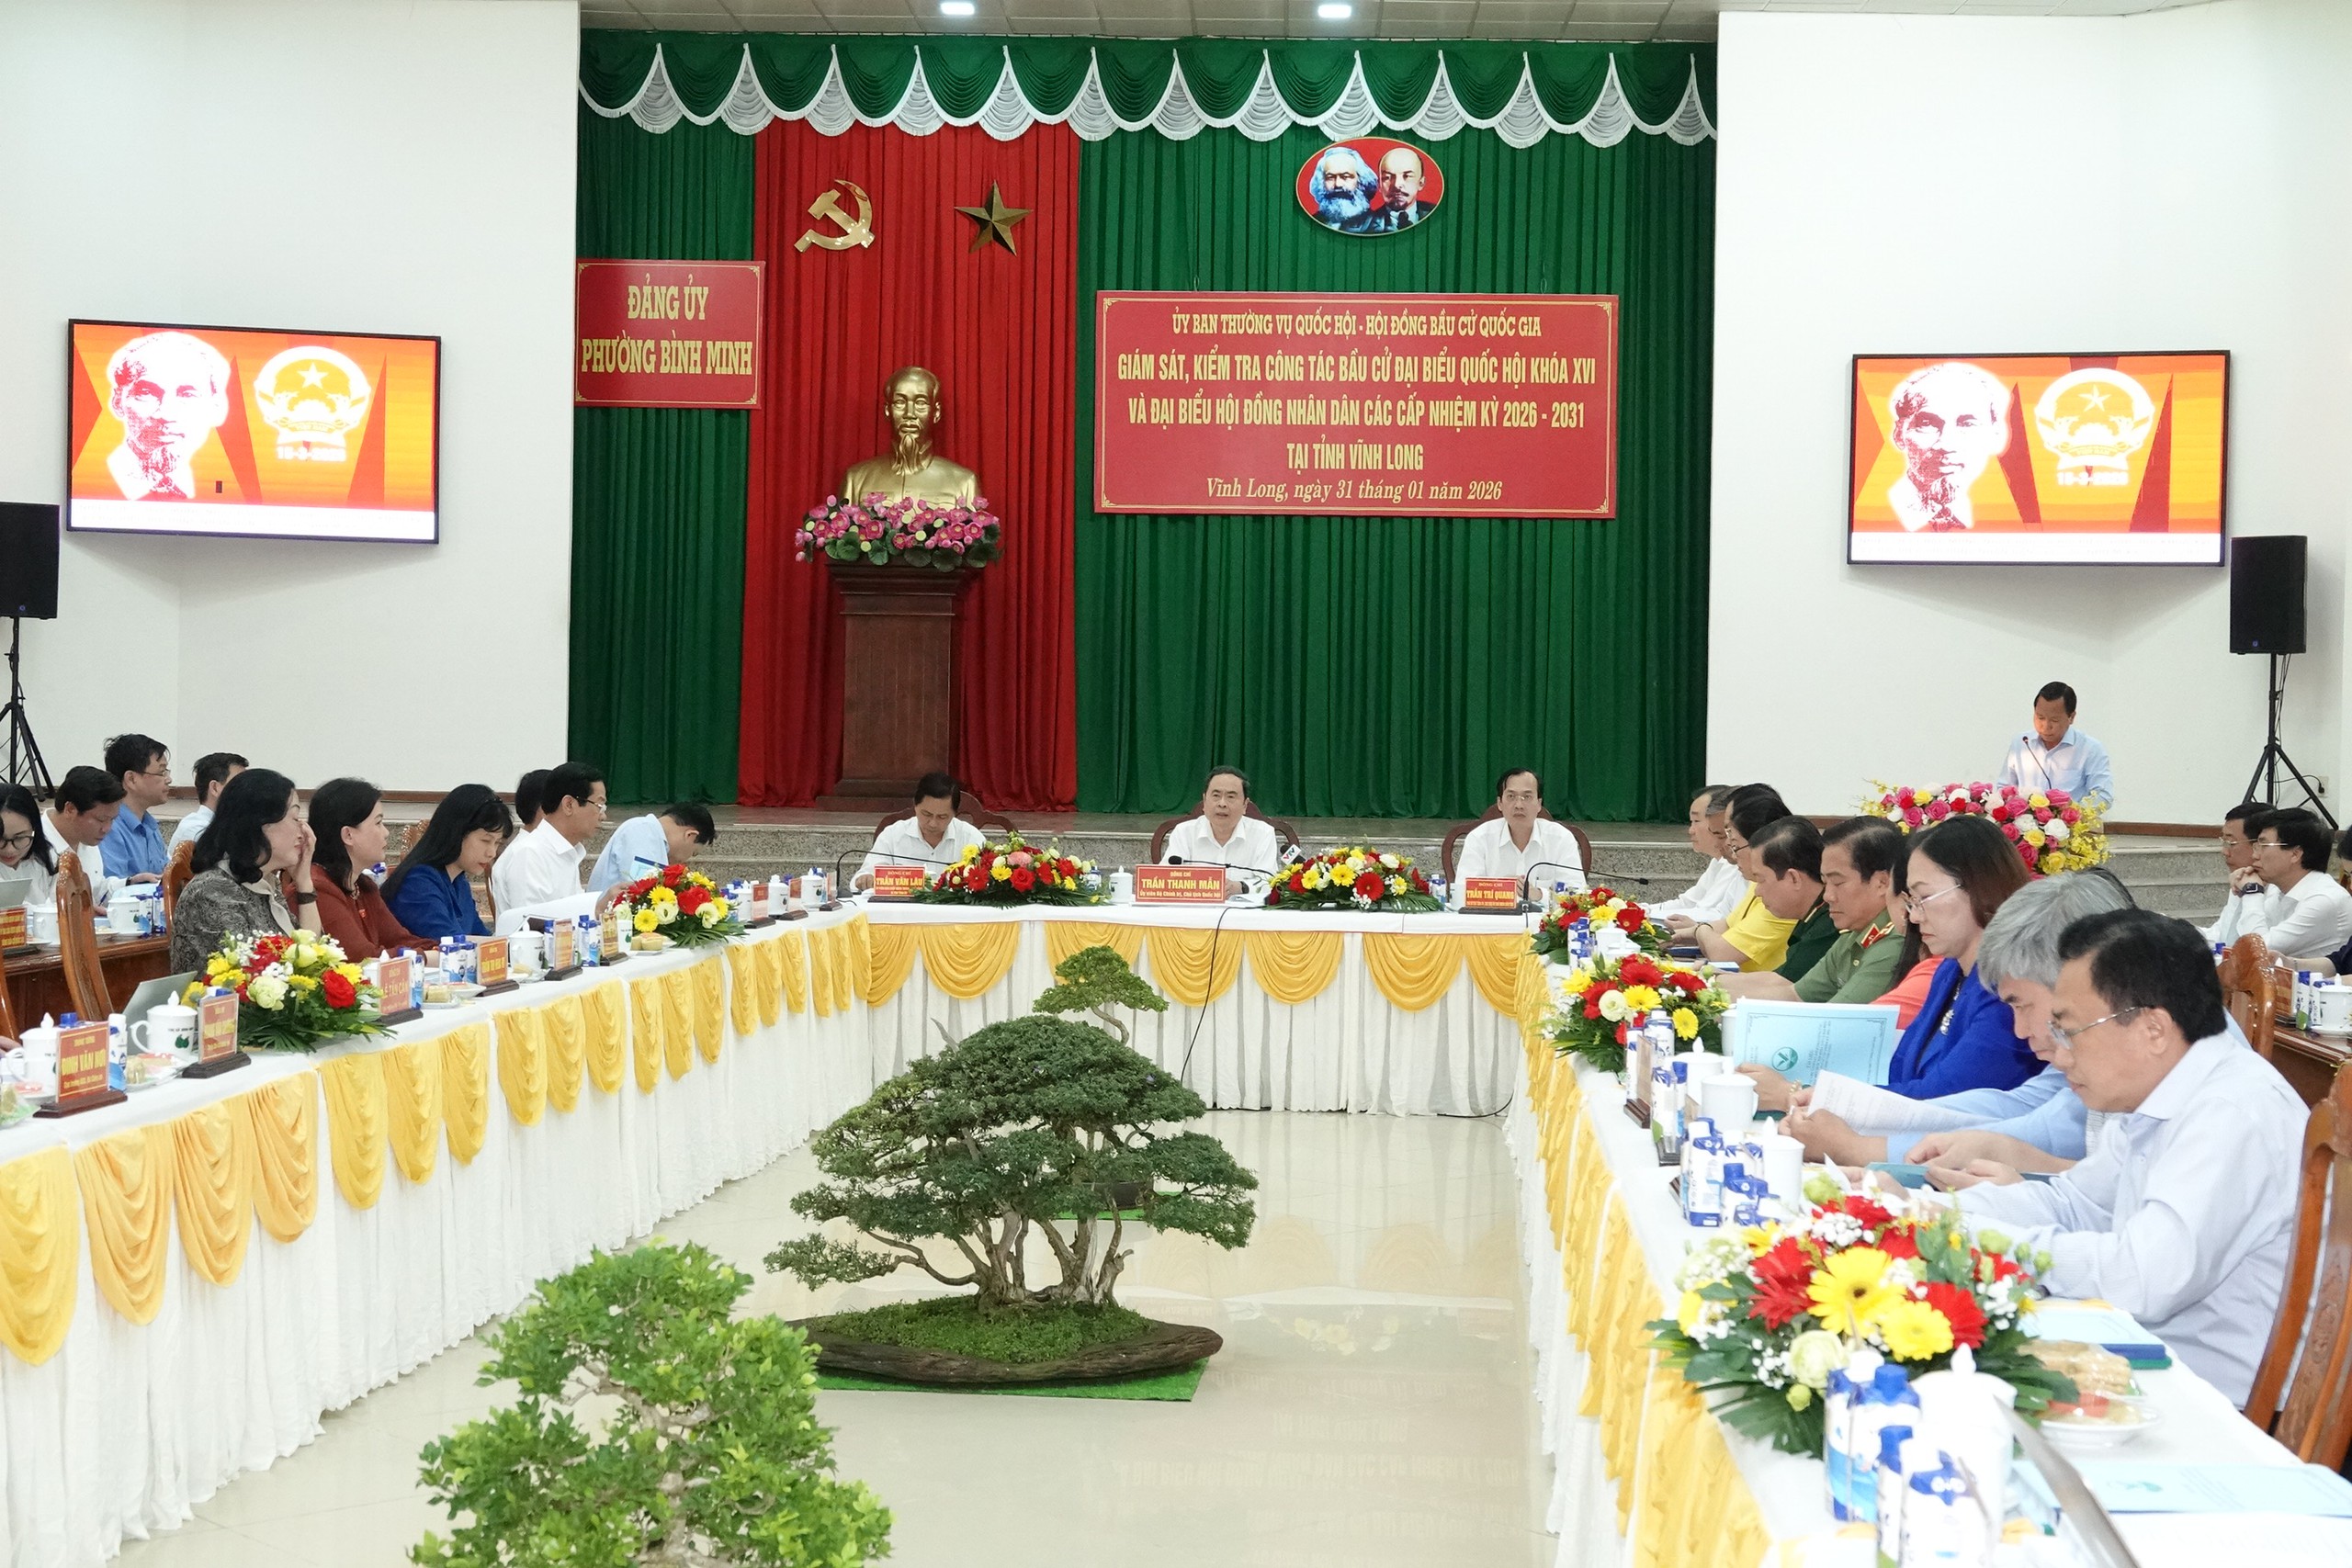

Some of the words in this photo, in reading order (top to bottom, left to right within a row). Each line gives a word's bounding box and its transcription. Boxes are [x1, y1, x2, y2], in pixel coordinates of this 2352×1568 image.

[628, 273, 680, 320] ĐẢNG
[684, 274, 709, 321] ỦY
[1171, 307, 1190, 333] ỦY
[1192, 314, 1218, 333] BAN
[1220, 309, 1272, 334] THƯỜNG
[1275, 315, 1293, 339] VỤ
[1295, 306, 1331, 336] QUỐC
[1333, 310, 1356, 340] HỘI
[1364, 310, 1388, 340] HỘI
[1390, 308, 1427, 335] ĐỒNG
[1429, 309, 1455, 335] BẦU
[1457, 309, 1477, 336] CỬ
[1478, 308, 1515, 337] QUỐC
[1518, 317, 1541, 336] GIA
[582, 330, 656, 373] PHƯỜNG
[660, 330, 702, 374] BÌNH
[707, 341, 752, 375] MINH
[1117, 349, 1154, 379] GIÁM
[1159, 349, 1189, 383] SÁT,
[1193, 344, 1230, 380] KIỂM
[1234, 355, 1261, 380] TRA
[1264, 350, 1304, 381] CÔNG
[1307, 350, 1334, 381] TÁC
[1339, 348, 1367, 382] BẦU
[1371, 346, 1392, 382] CỬ
[1394, 356, 1418, 388] ĐẠI
[1422, 346, 1455, 382] BIỂU
[1460, 348, 1498, 385] QUỐC
[1502, 352, 1526, 389] HỘI
[1530, 352, 1568, 383] KHÓA
[1572, 358, 1595, 383] XVI
[1128, 392, 1147, 423] VÀ
[1149, 399, 1173, 429] ĐẠI
[1178, 389, 1211, 424] BIỂU
[1216, 393, 1239, 430] HỘI
[1242, 391, 1282, 425] ĐỒNG
[1286, 394, 1326, 425] NHÂN
[1329, 394, 1360, 425] DÂN
[1363, 395, 1392, 426] CÁC
[1396, 392, 1425, 426] CẤP
[1429, 396, 1476, 432] NHIỆM
[1480, 396, 1498, 426] KỲ
[1502, 401, 1537, 427] 2026
[1551, 402, 1583, 427] 2031
[1286, 444, 1308, 475] TẠI
[1312, 434, 1345, 469] TỈNH
[1349, 439, 1382, 469] VĨNH
[1386, 444, 1423, 470] LONG
[1206, 478, 1241, 497] Vĩnh
[1245, 479, 1288, 502] Long,
[1293, 479, 1332, 502] ngày
[1336, 479, 1352, 498] 31
[1358, 479, 1404, 503] tháng
[1408, 480, 1423, 499] 01
[1428, 482, 1462, 499] năm
[1466, 481, 1502, 500] 2026
[1141, 876, 1165, 888] TRẦN
[1168, 879, 1196, 889] THANH
